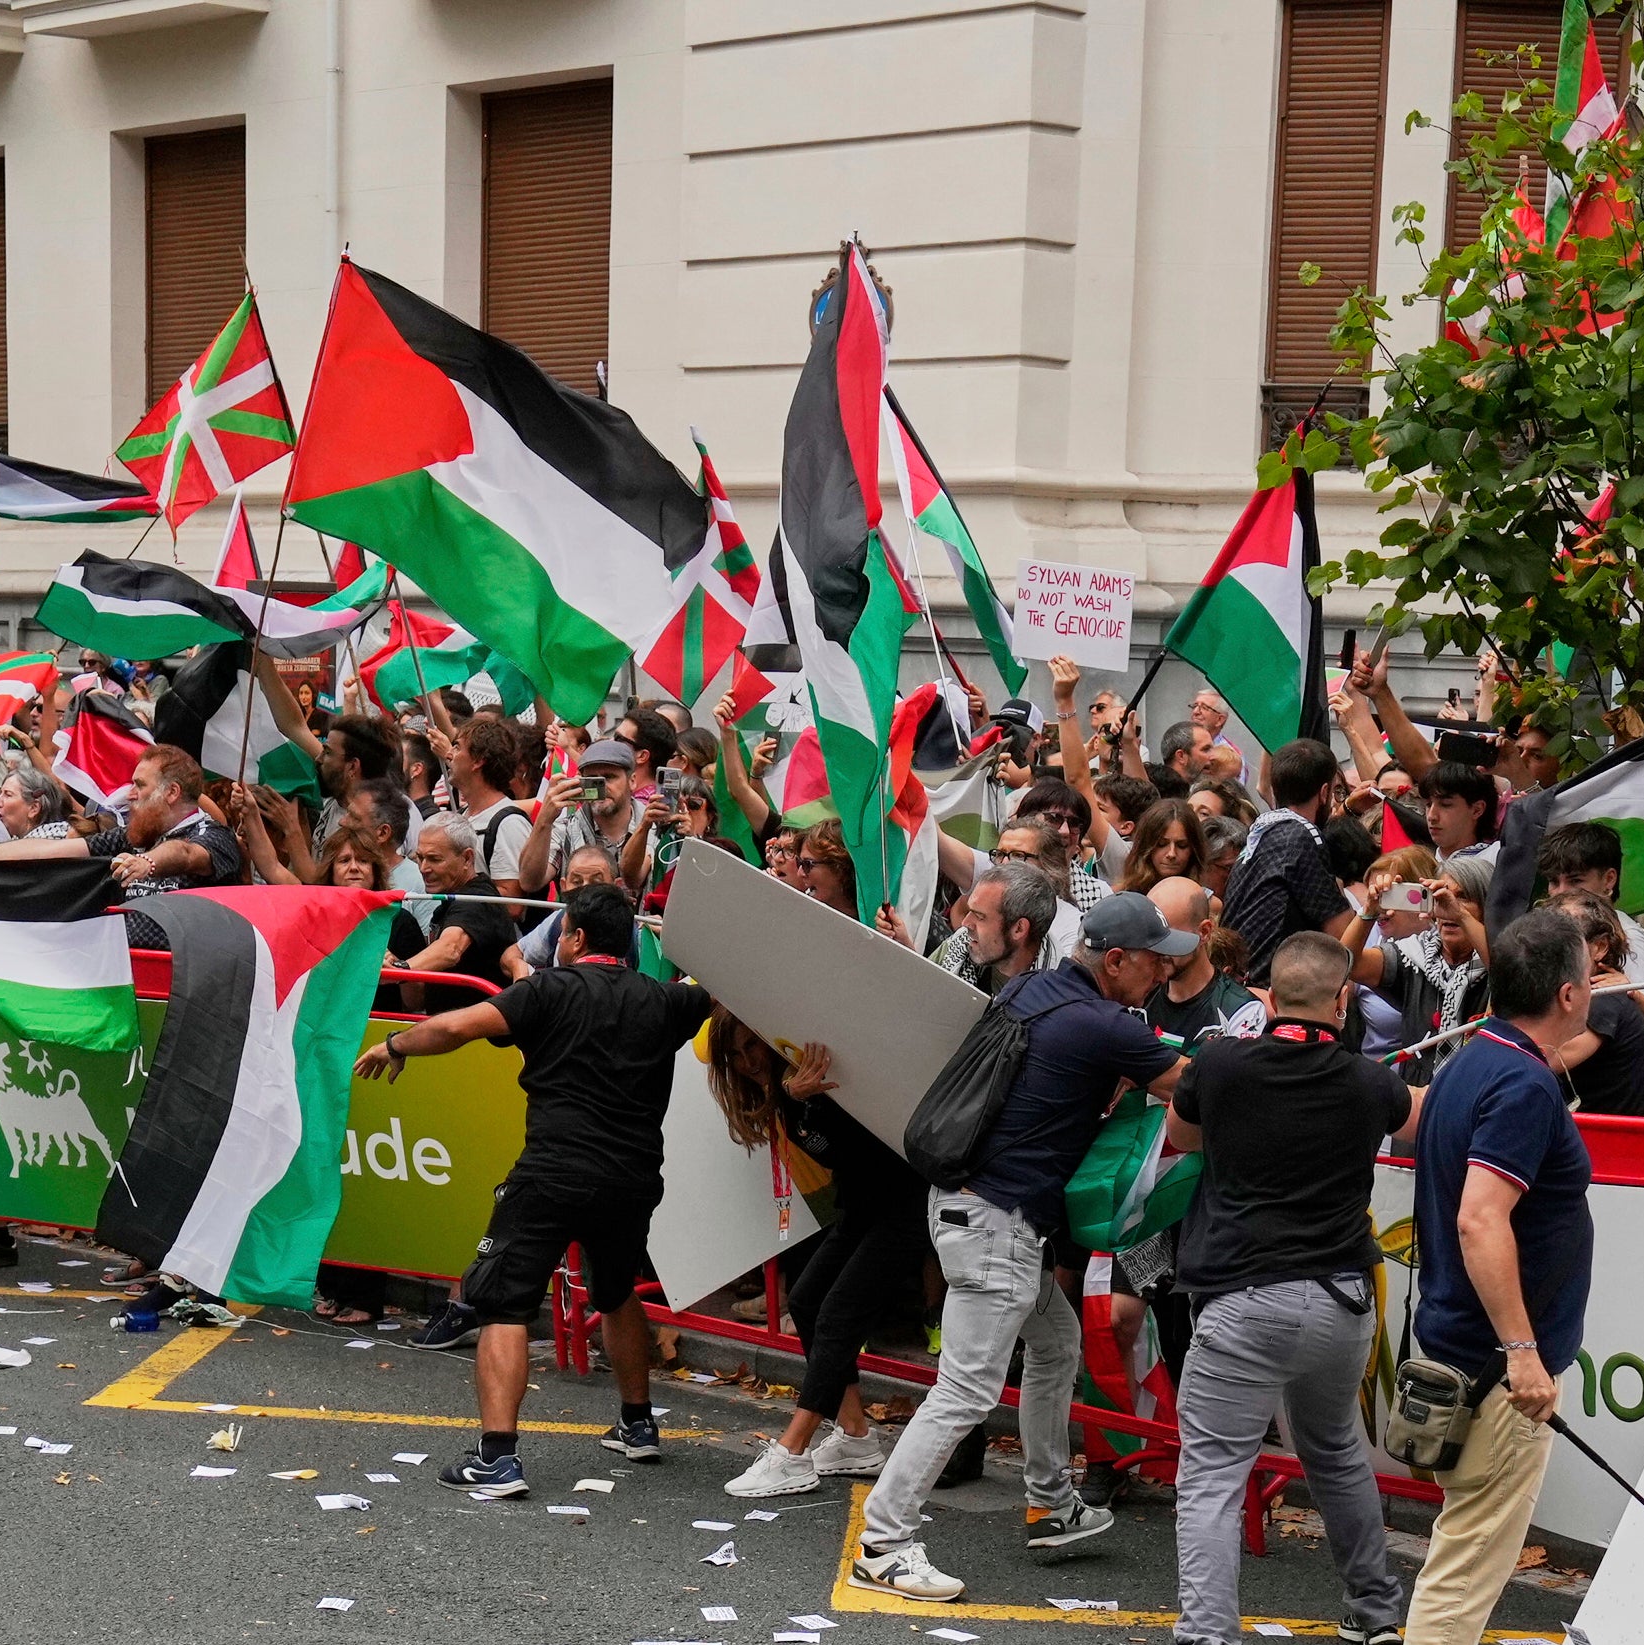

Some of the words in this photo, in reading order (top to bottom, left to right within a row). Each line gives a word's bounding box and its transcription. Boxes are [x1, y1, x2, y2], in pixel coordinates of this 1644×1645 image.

[1028, 566, 1081, 587] SYLVAN
[1018, 588, 1031, 600] DO
[1038, 592, 1066, 606] NOT
[1074, 593, 1112, 612] WASH
[1027, 610, 1045, 626] THE
[1055, 611, 1125, 639] GENOCIDE
